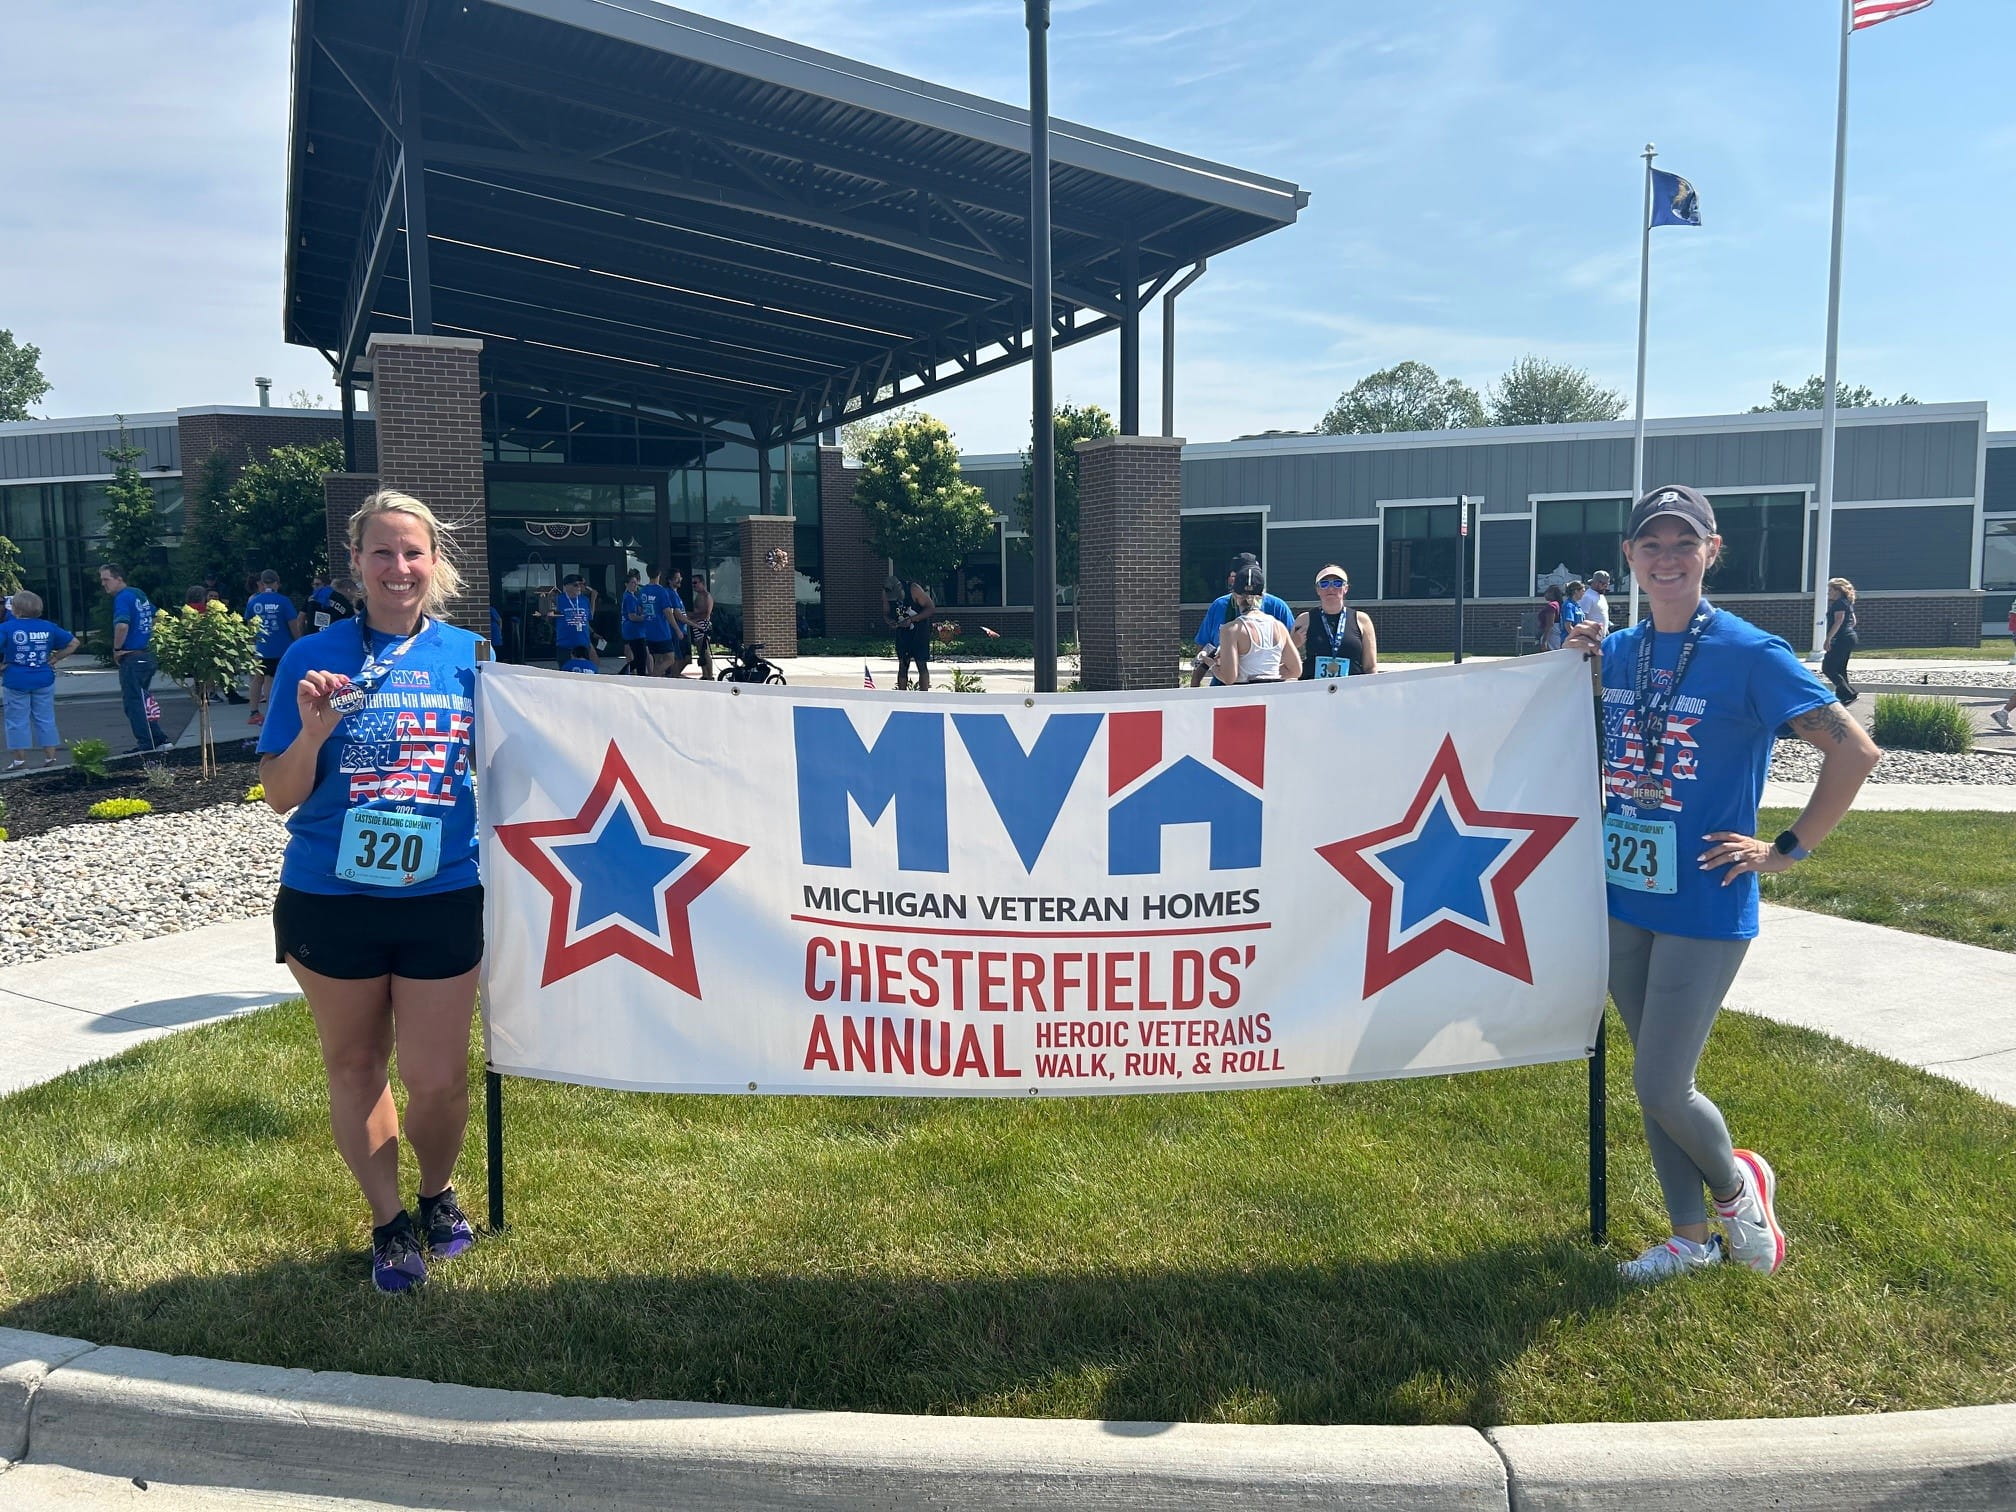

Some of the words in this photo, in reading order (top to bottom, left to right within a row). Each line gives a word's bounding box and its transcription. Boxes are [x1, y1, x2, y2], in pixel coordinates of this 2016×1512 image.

[390, 669, 431, 685] MVH
[330, 688, 364, 709] HEROIC
[361, 693, 400, 709] TERFIELD
[402, 692, 418, 708] 4TH
[421, 692, 451, 709] ANNUAL
[1675, 695, 1706, 715] HEROIC
[344, 711, 474, 746] WALK
[340, 744, 447, 773] RUN
[1672, 749, 1699, 780] &
[350, 773, 457, 807] ROLL
[793, 705, 1266, 875] MVH
[1633, 787, 1664, 800] HEROIC
[354, 813, 381, 826] EASTSIDE
[381, 817, 404, 828] RACING
[404, 819, 432, 831] COMPANY
[355, 829, 423, 873] 320
[1607, 832, 1658, 877] 323
[803, 885, 967, 919] MICHIGAN
[977, 895, 1129, 922] VETERAN
[1143, 888, 1260, 921] HOMES
[804, 936, 1257, 1012] CHESTERFIELDS'
[803, 1014, 1022, 1078] ANNUAL
[1036, 1020, 1129, 1048] HEROIC
[1138, 1012, 1272, 1048] VETERANS
[1035, 1053, 1116, 1081] WALK,
[1124, 1052, 1183, 1080] RUN,
[1192, 1052, 1212, 1075] &
[1221, 1048, 1286, 1074] ROLL
